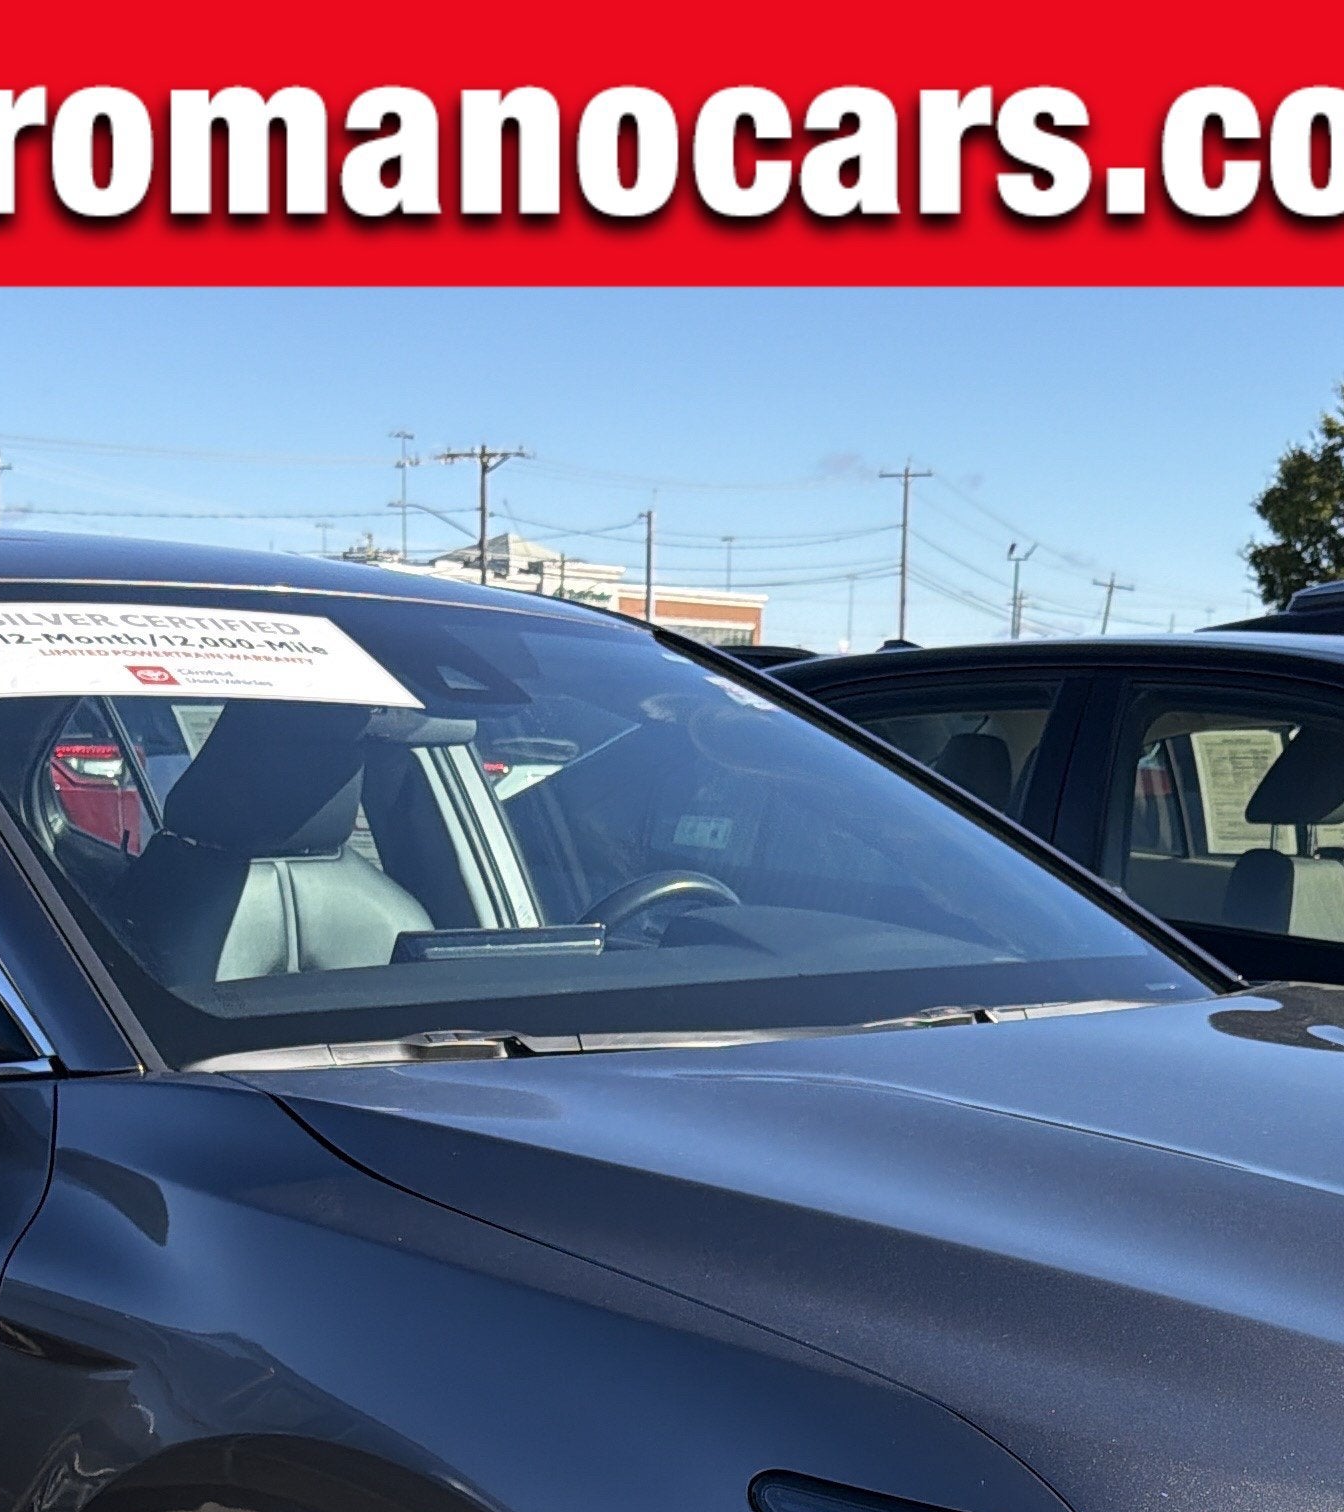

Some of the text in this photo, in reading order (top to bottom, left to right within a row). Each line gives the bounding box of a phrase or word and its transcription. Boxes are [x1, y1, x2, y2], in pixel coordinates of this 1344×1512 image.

[119, 613, 301, 636] CERTIFIED
[37, 648, 314, 666] LIMITED POWERTRAIN WARRANTY
